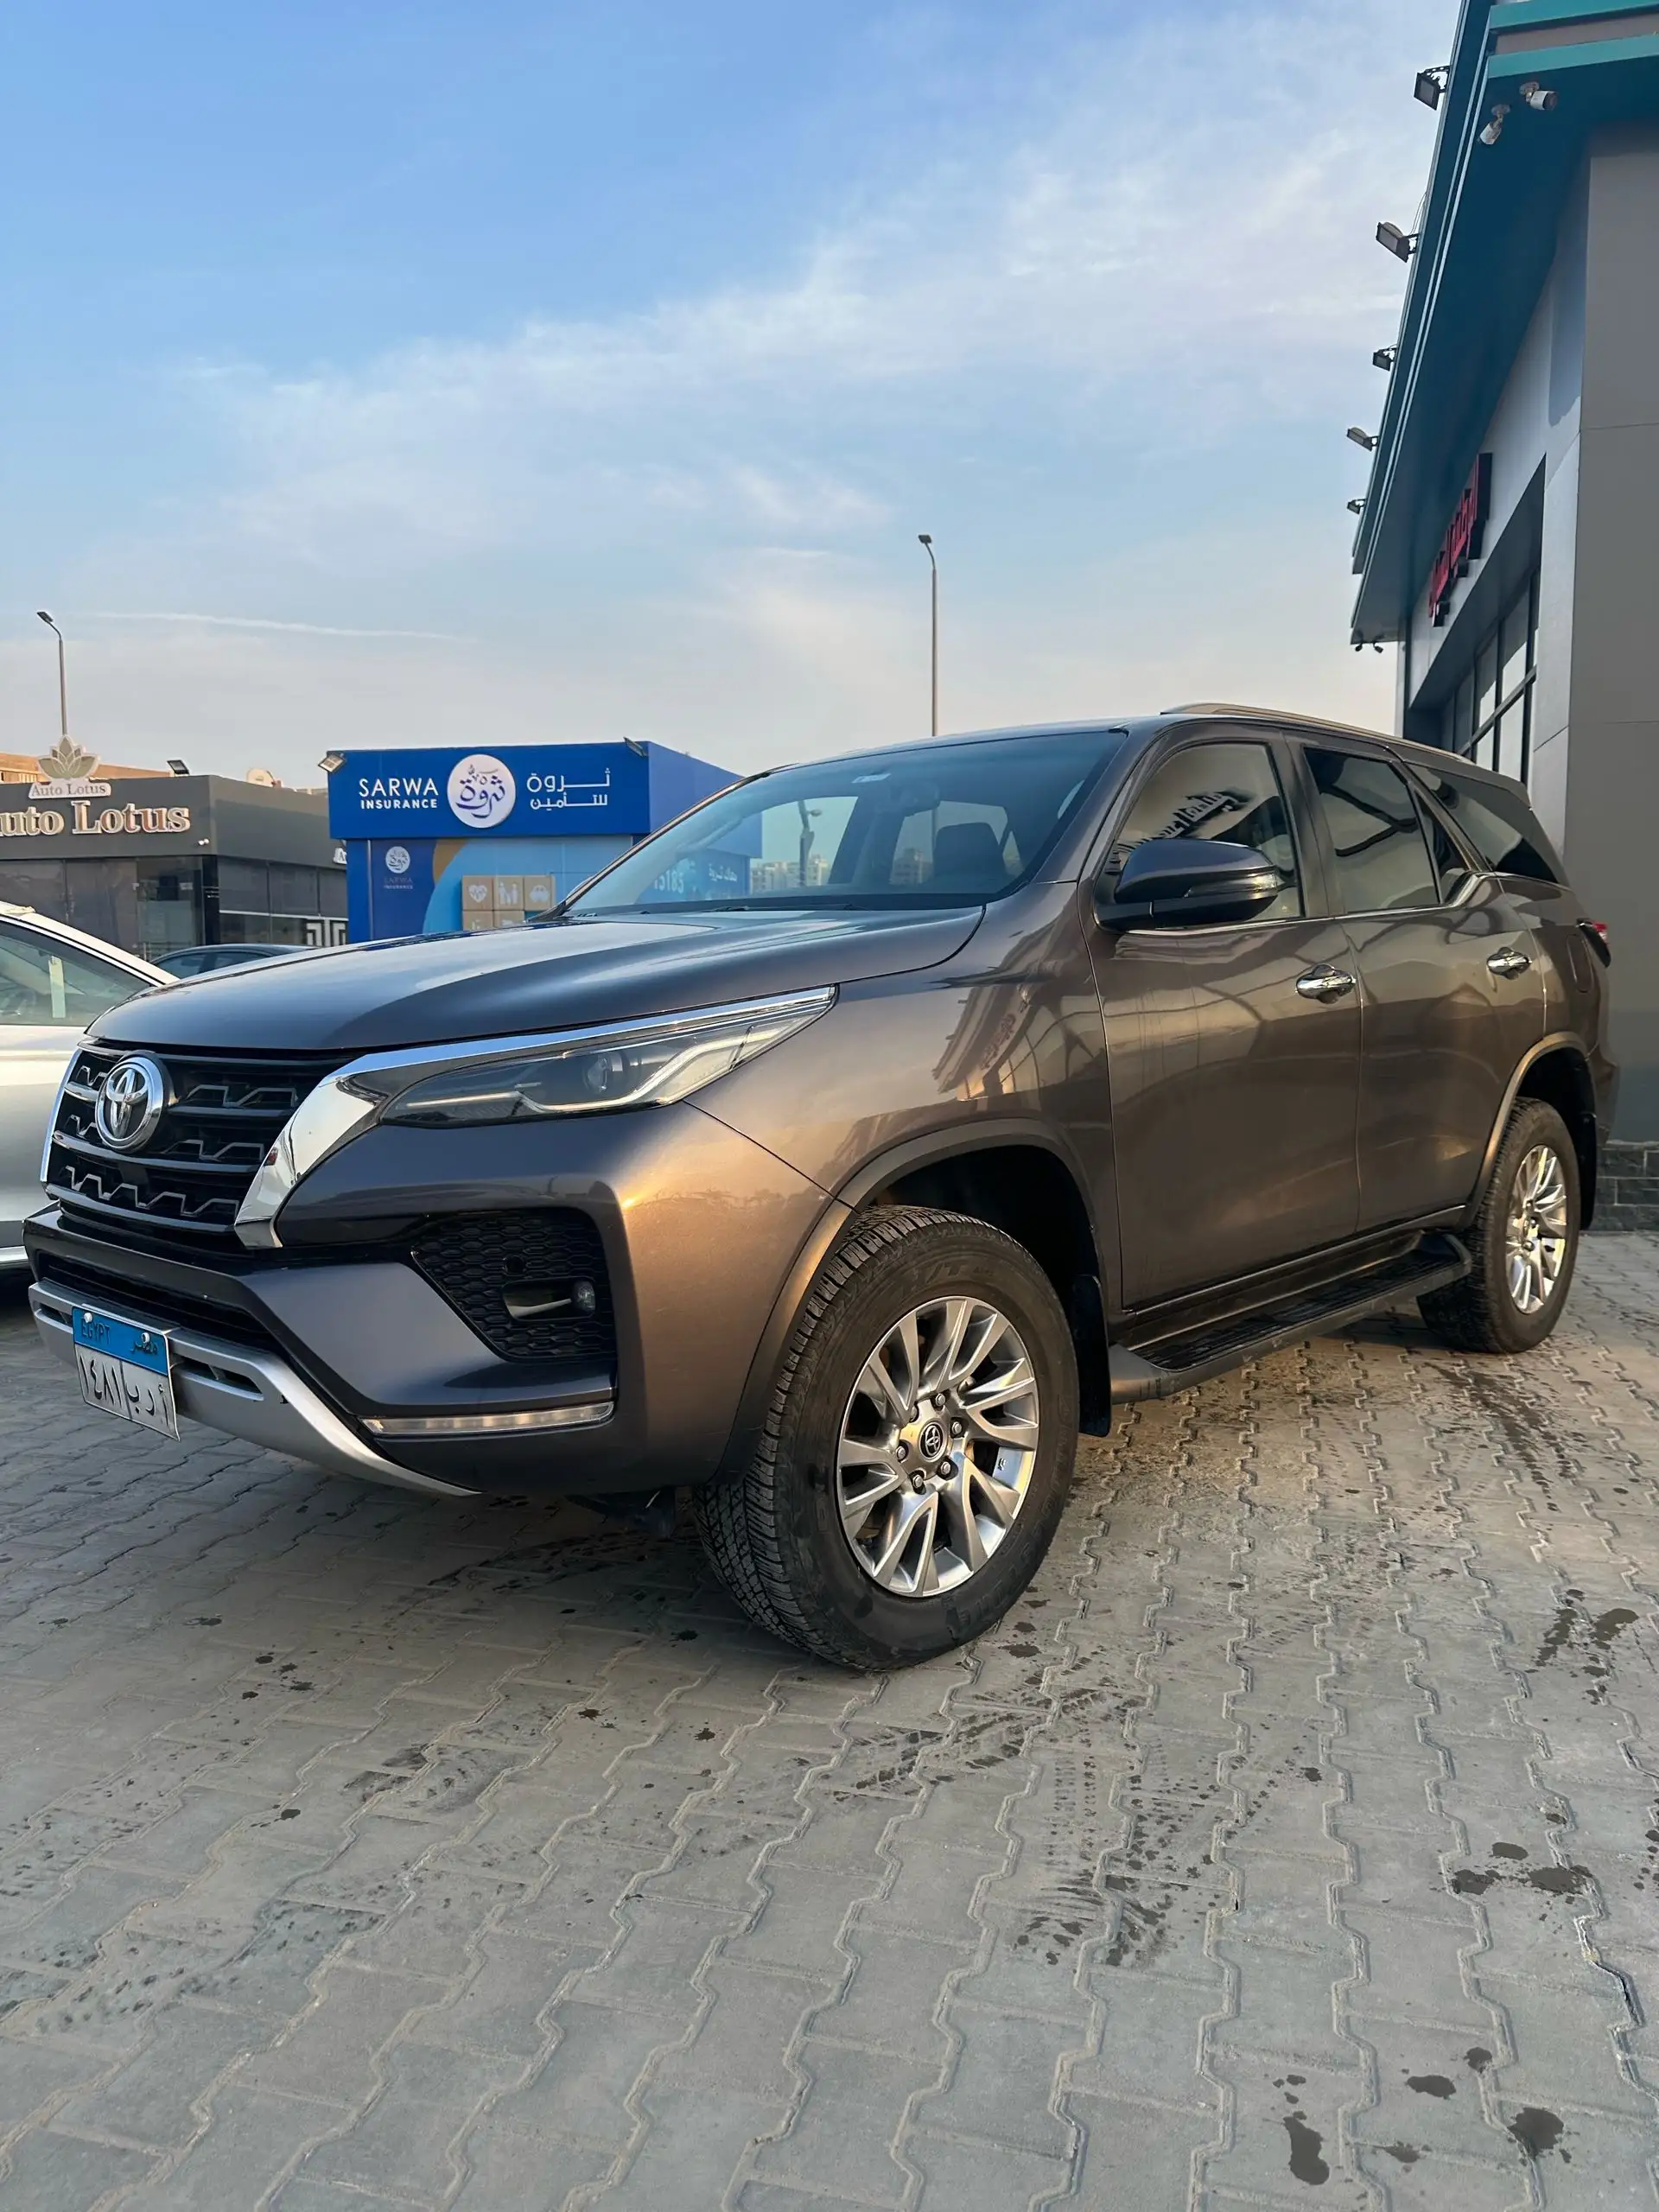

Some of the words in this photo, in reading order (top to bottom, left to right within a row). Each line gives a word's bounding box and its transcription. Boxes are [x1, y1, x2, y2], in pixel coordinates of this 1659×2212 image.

[359, 778, 439, 797] SARWA
[527, 767, 611, 792] ثروة
[31, 785, 63, 797] Auto
[67, 783, 106, 796] Lotus
[360, 798, 438, 810] INSURANCE
[530, 791, 608, 810] للتأمين
[0, 806, 65, 837] uto
[71, 800, 190, 835] Lotus
[81, 1318, 111, 1345] EGYPT
